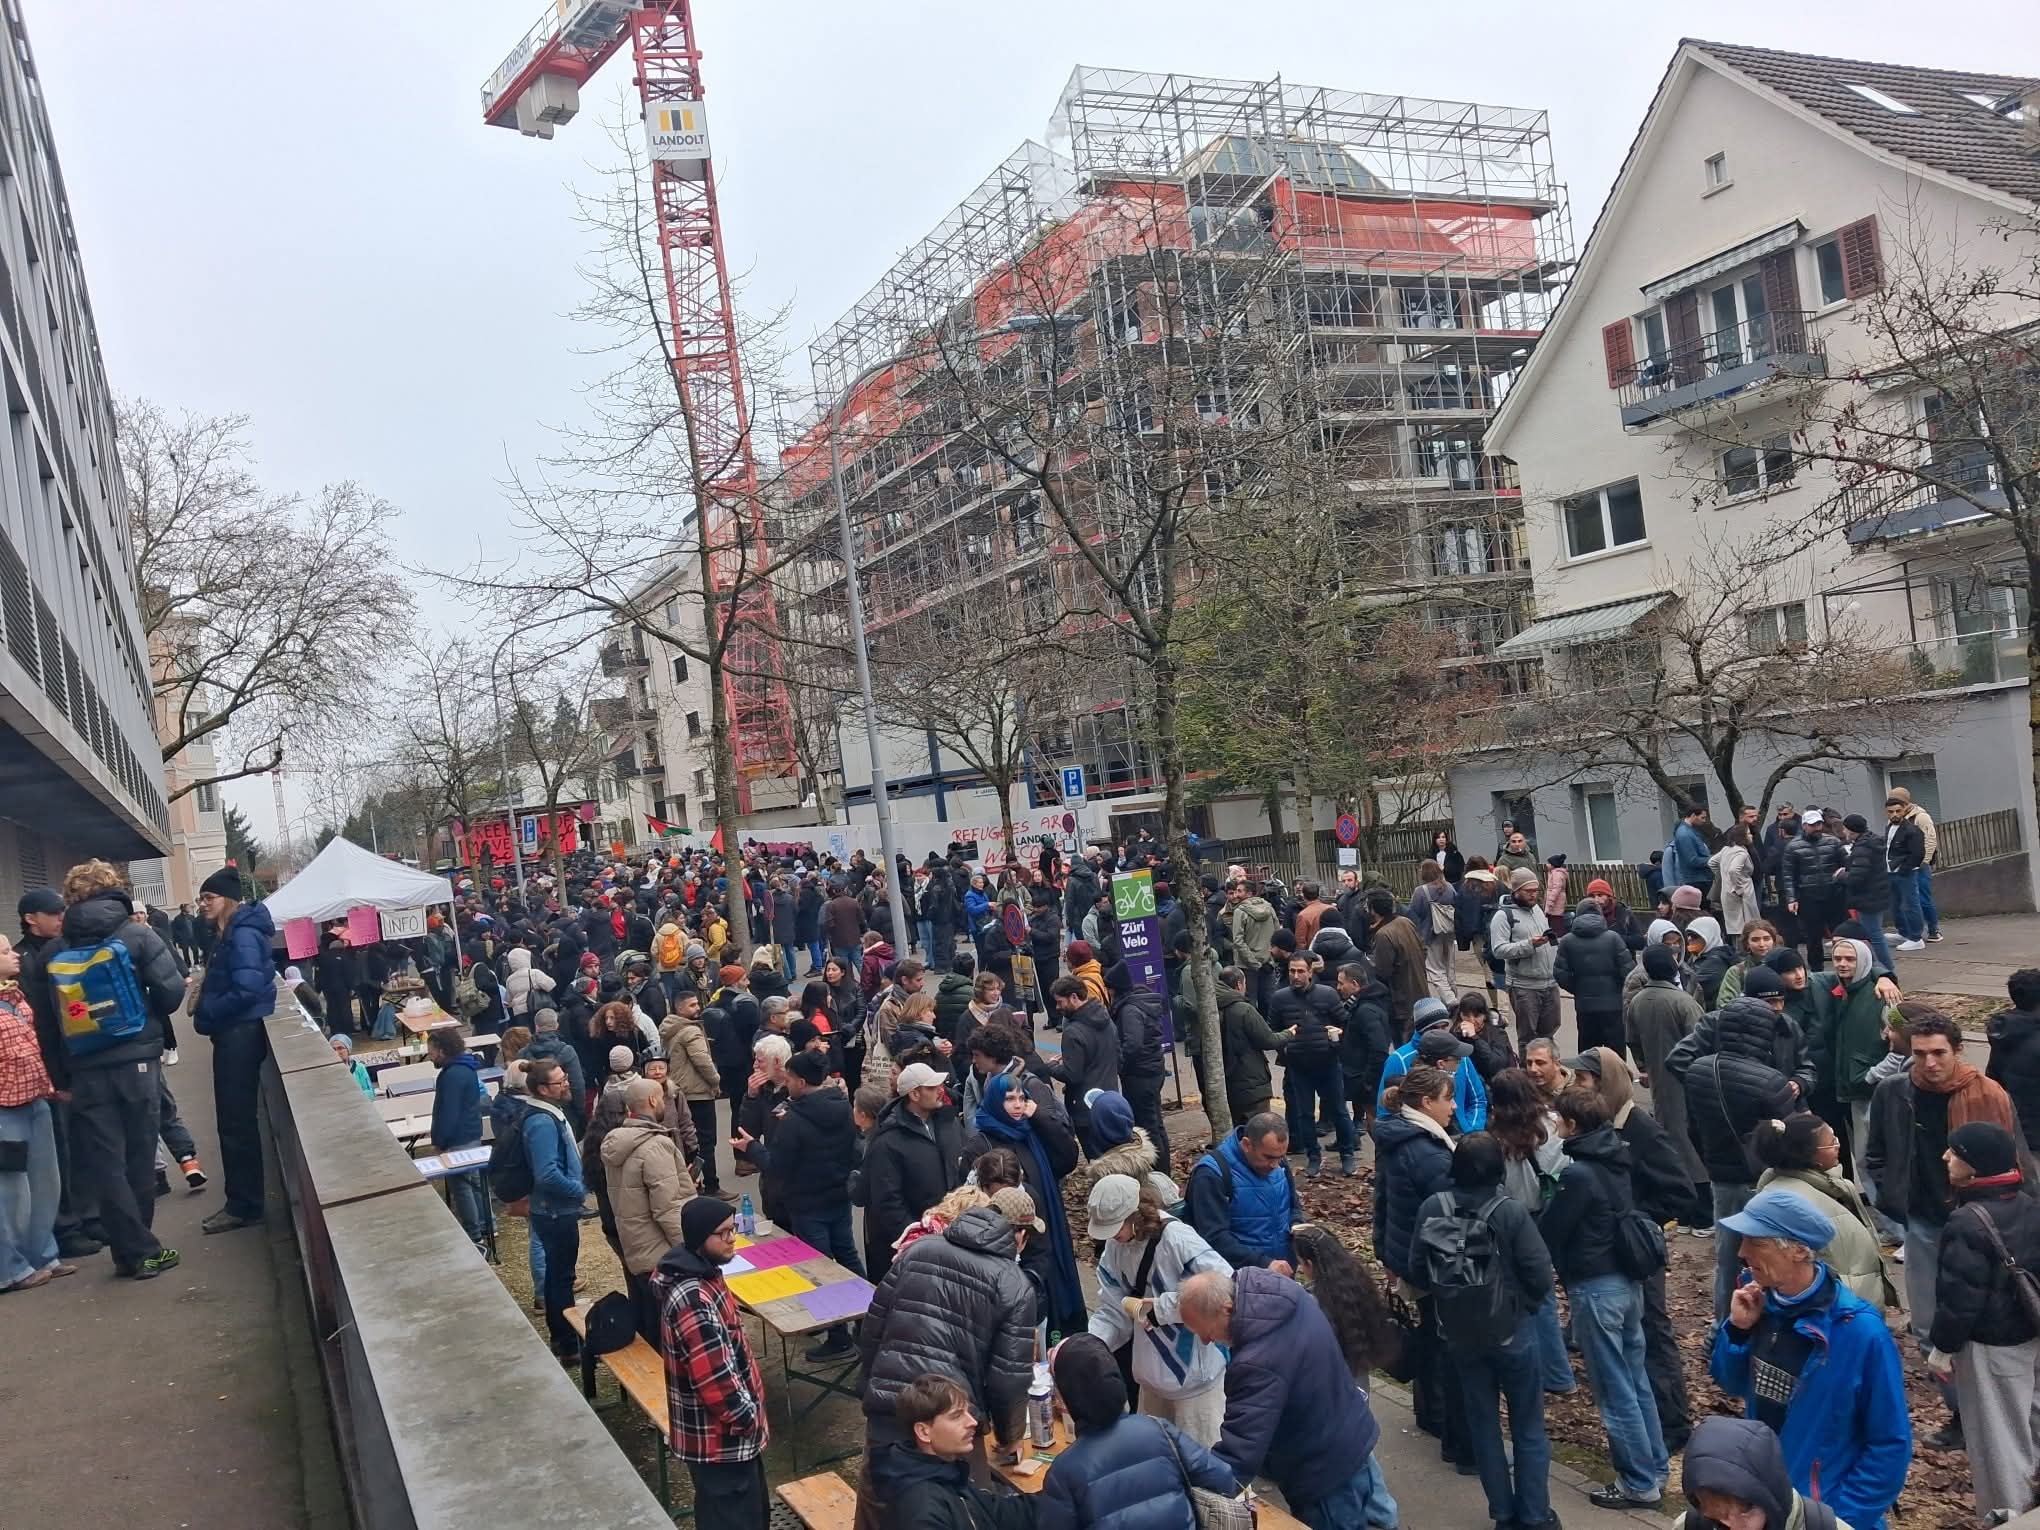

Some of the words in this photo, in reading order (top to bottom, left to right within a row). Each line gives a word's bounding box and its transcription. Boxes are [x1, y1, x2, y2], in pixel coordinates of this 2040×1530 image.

[502, 36, 530, 77] LANDOLT
[652, 134, 705, 145] LANDOLT
[388, 915, 419, 934] INFO
[1121, 920, 1145, 935] Züri
[1122, 936, 1148, 949] Velo
